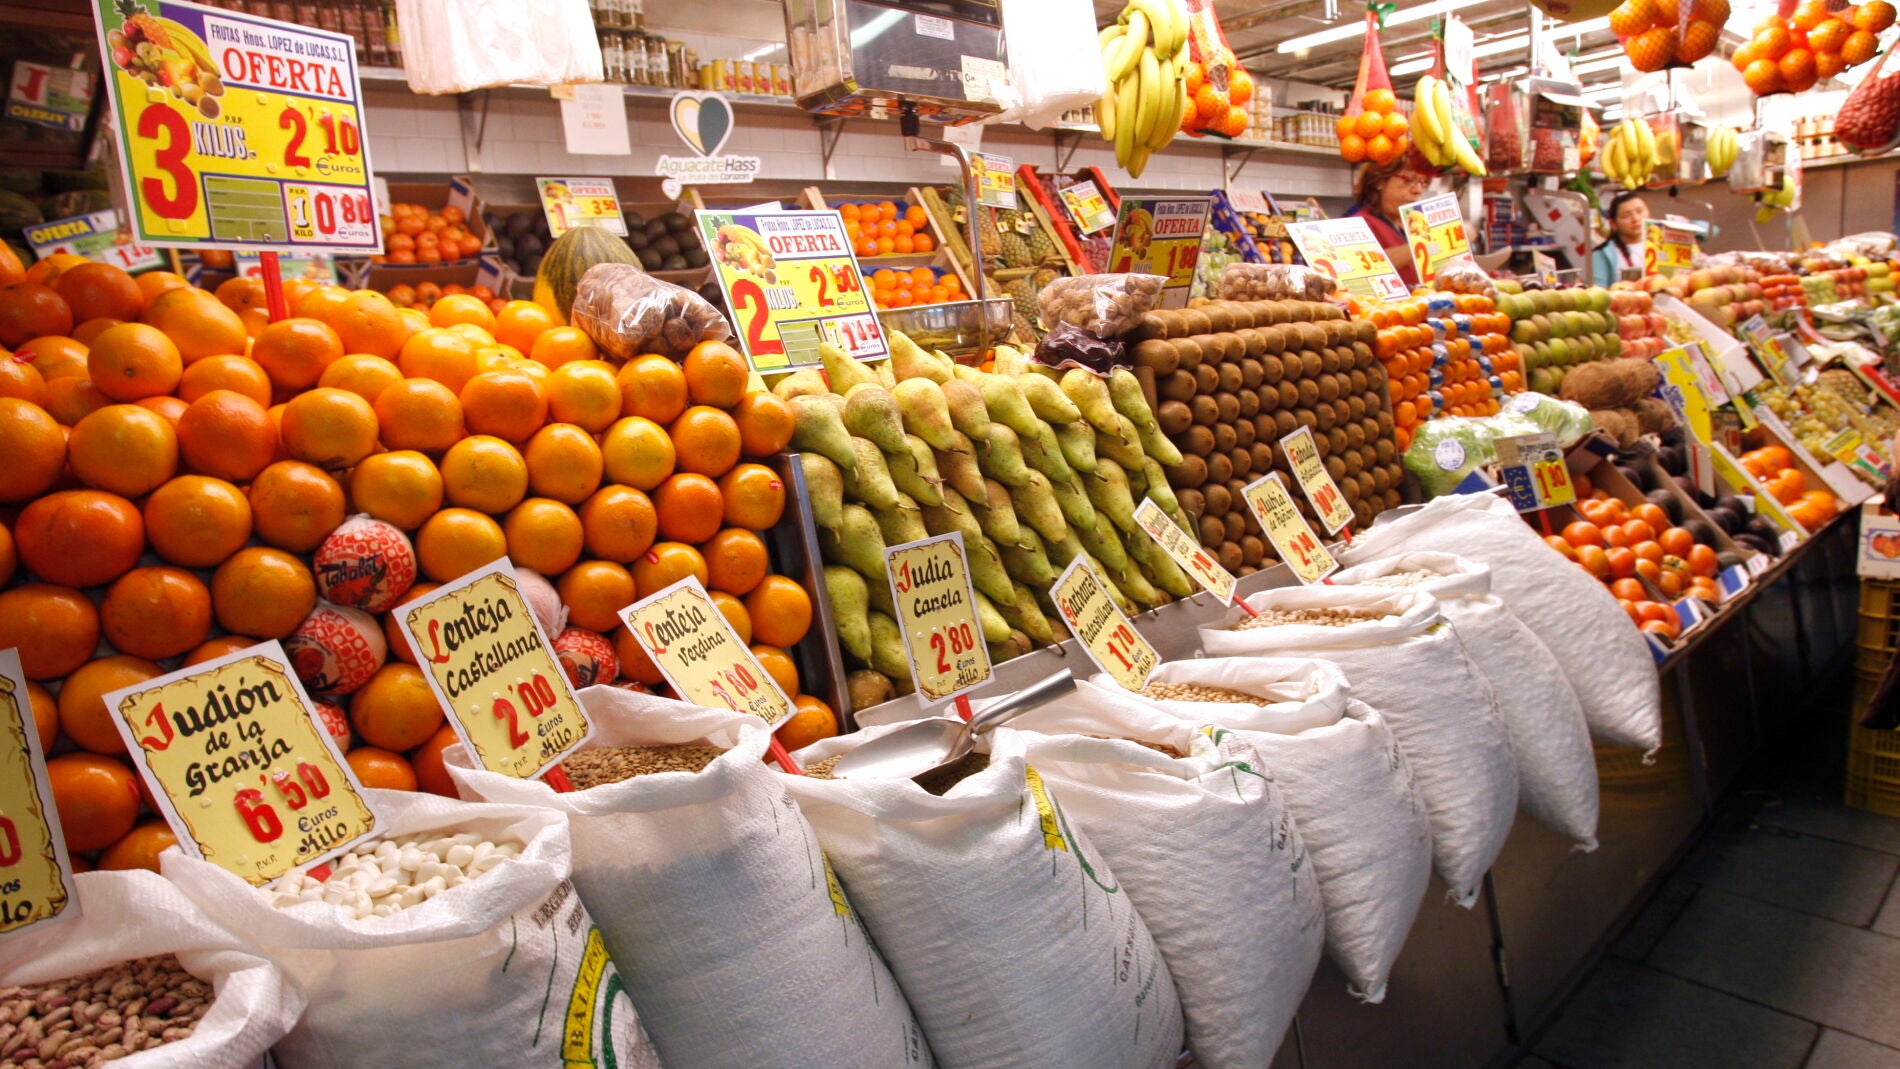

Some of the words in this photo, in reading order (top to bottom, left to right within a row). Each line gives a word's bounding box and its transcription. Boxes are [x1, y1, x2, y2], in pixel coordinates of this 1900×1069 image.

[211, 24, 240, 43] FRUTAS
[243, 30, 266, 48] Hnos.
[268, 35, 293, 52] LOPEZ
[294, 41, 304, 55] de
[223, 47, 347, 98] OFERTA
[138, 104, 198, 220] 3
[279, 106, 360, 168] 2'10
[30, 219, 93, 244] OFERTA
[293, 197, 310, 228] 1
[314, 192, 372, 235] 0'80
[294, 229, 312, 238] KILO
[1154, 218, 1200, 234] OFERTA
[1329, 232, 1369, 244] OFERTA
[769, 234, 841, 254] OFERTA
[1415, 242, 1436, 283] 2
[731, 279, 784, 356] 2
[1062, 574, 1097, 627] Garbanzo
[428, 598, 512, 664] Lenteja
[644, 604, 706, 656] Lenteja
[930, 622, 974, 674] 2'80
[1107, 624, 1135, 672] 1'70
[493, 673, 557, 750] 2'00
[710, 662, 758, 714] 1'80
[141, 677, 283, 751] Judión
[205, 731, 232, 755] de
[236, 721, 266, 742] la
[186, 737, 293, 798] Granja
[540, 728, 572, 759] Kilo
[233, 762, 330, 844] 6'50
[296, 822, 348, 856] Kilo
